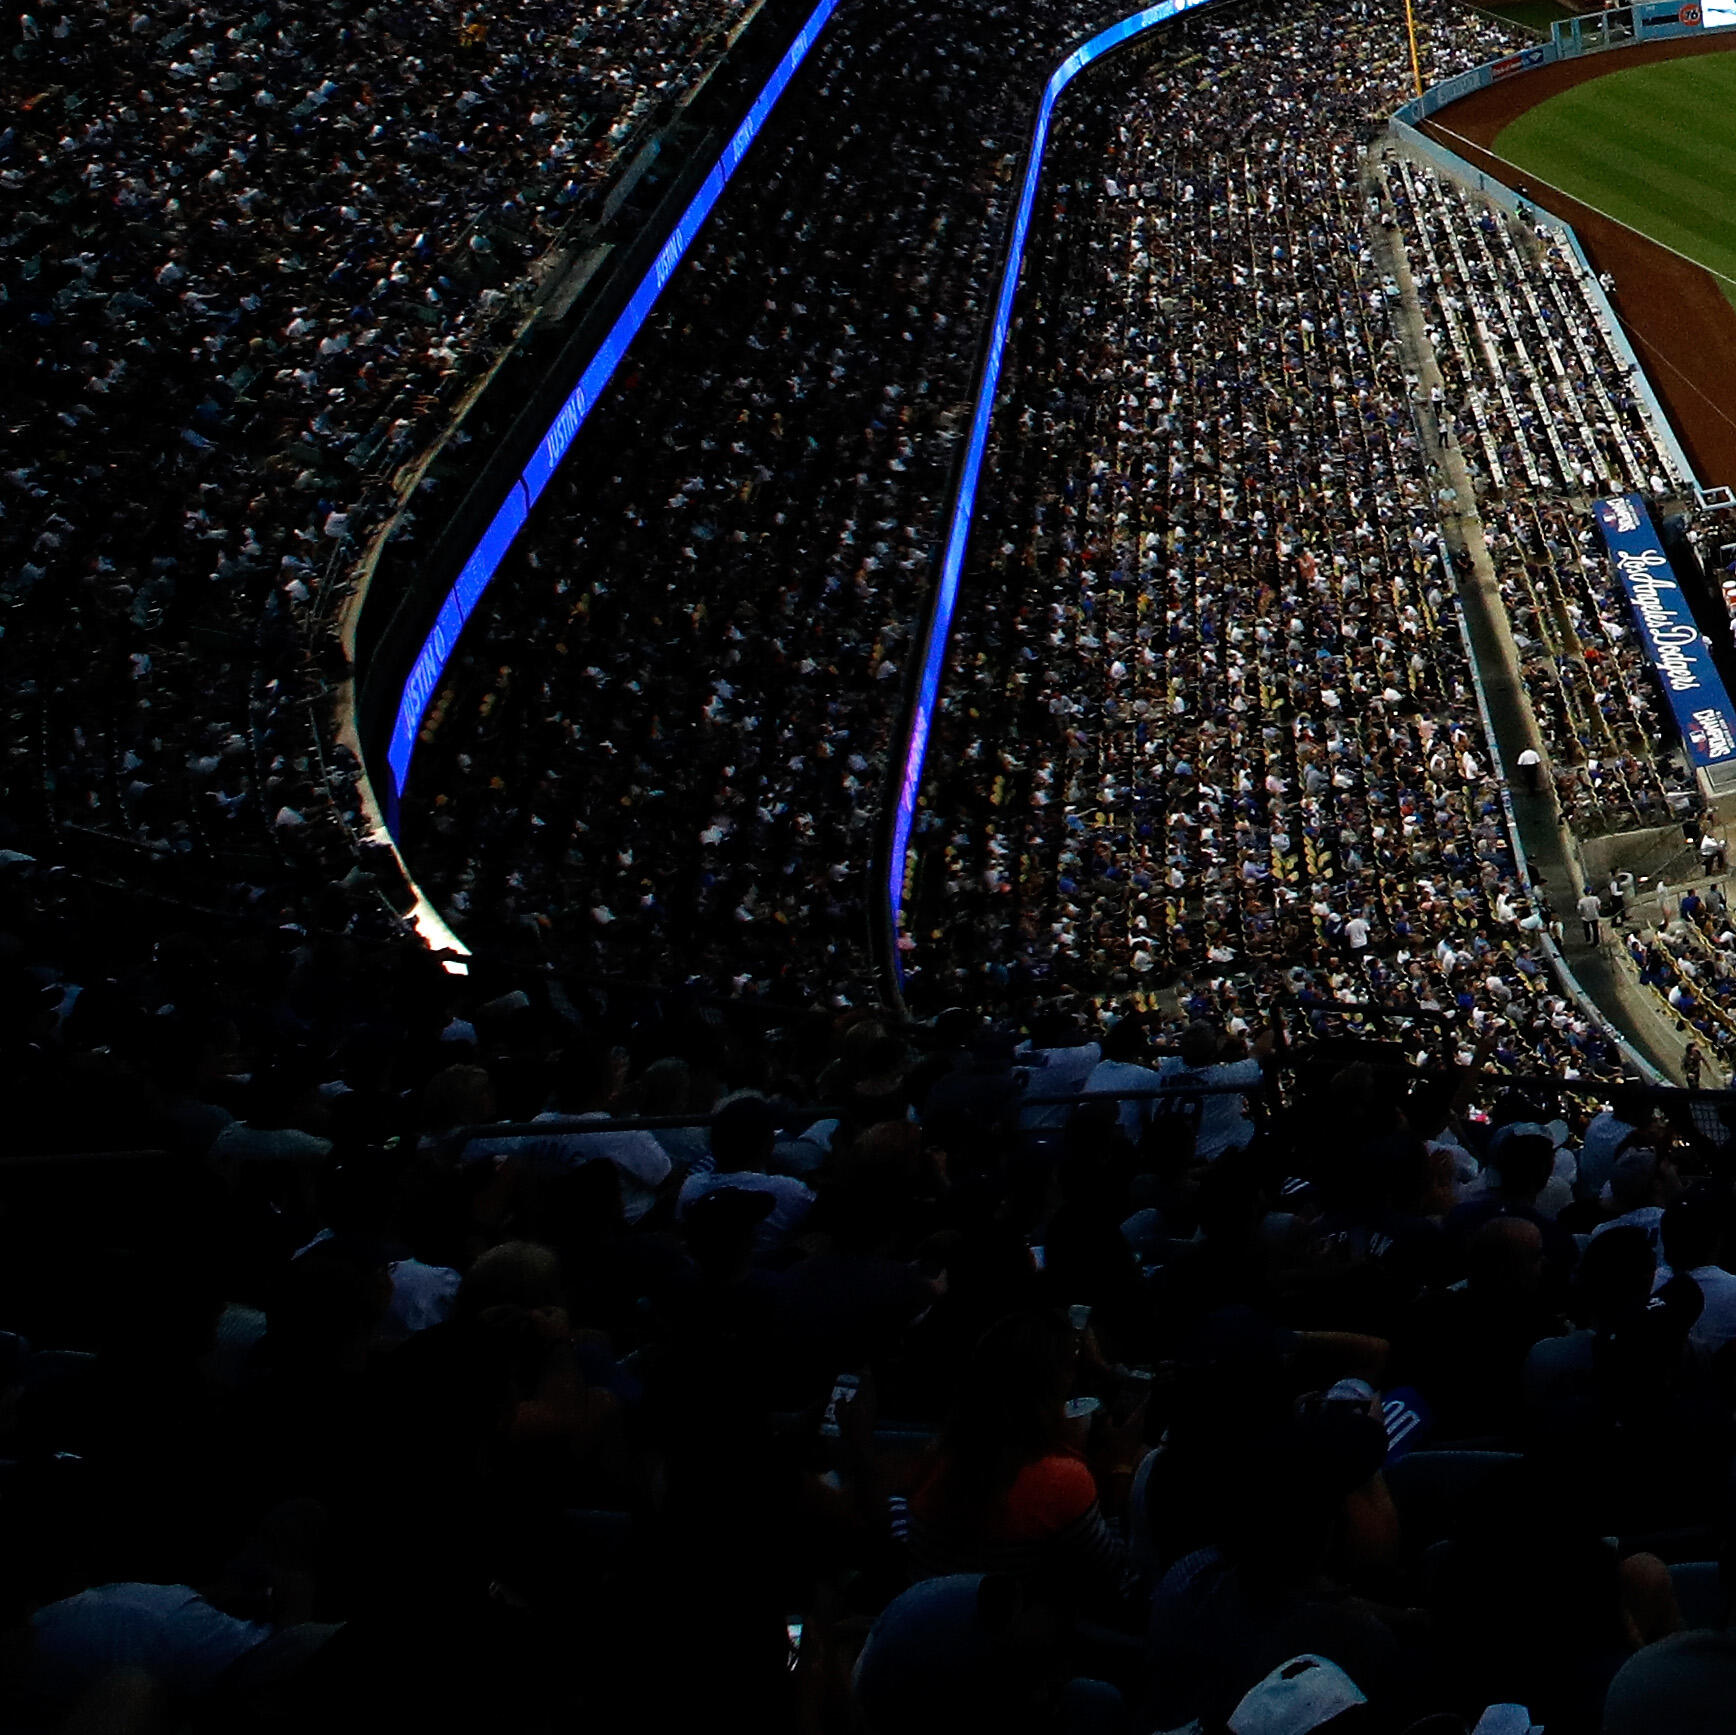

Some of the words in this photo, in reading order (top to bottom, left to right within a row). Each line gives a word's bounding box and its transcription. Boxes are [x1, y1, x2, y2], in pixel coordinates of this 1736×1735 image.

[1617, 549, 1667, 576] Los
[1629, 573, 1685, 632] Angeles
[1653, 625, 1702, 692] Dodgers
